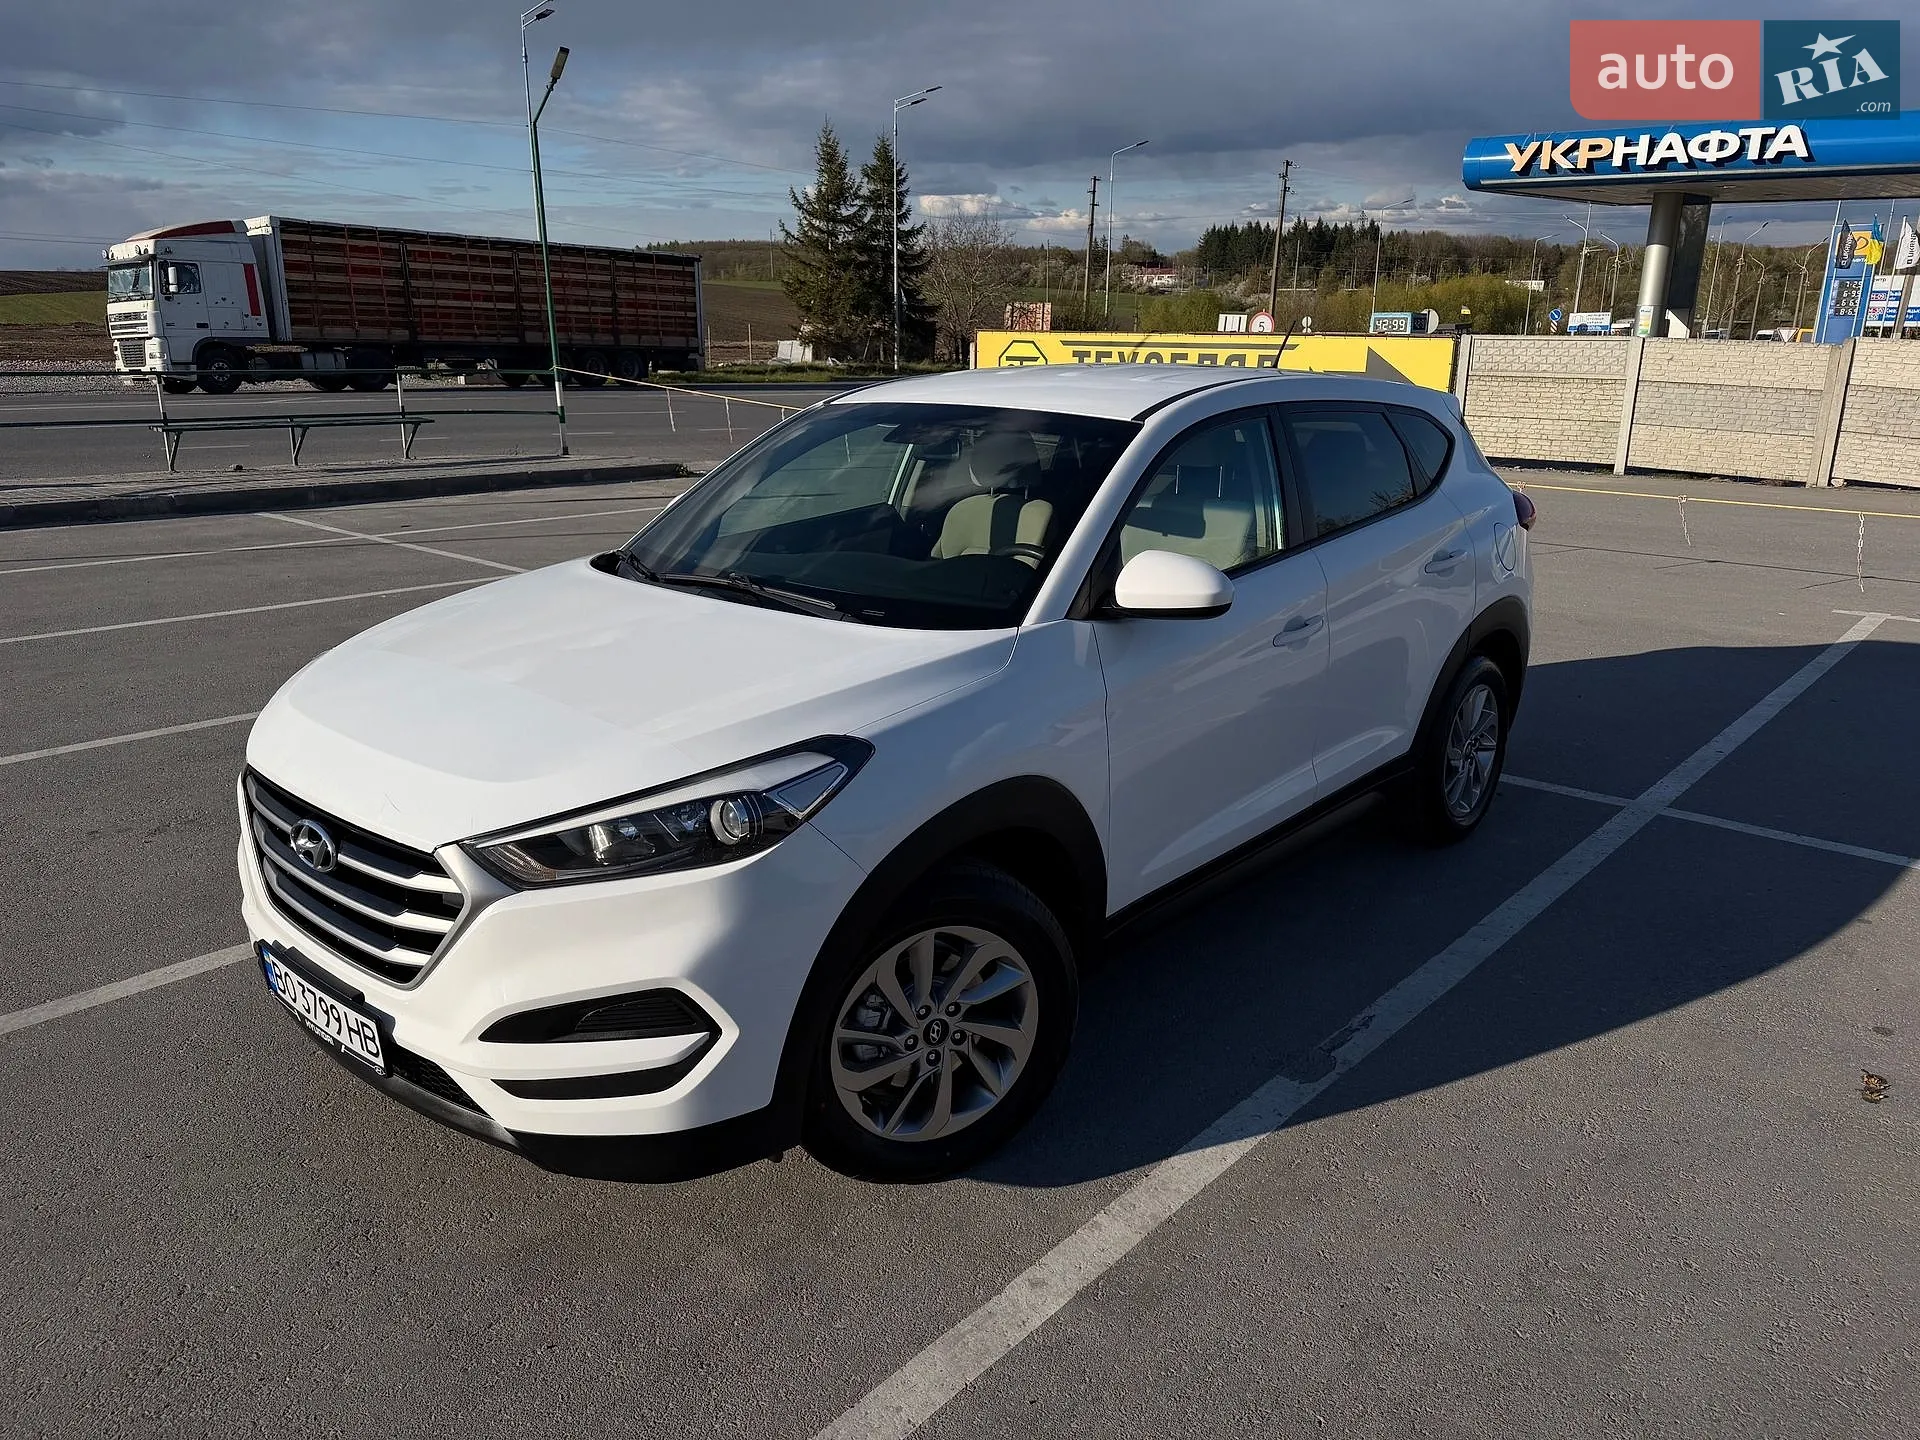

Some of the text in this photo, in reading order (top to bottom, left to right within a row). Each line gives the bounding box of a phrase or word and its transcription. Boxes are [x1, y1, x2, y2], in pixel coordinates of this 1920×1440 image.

[1504, 124, 1809, 172] УКРНАФТА
[1258, 321, 1265, 333] 5
[271, 959, 380, 1059] BO 3799 HB
